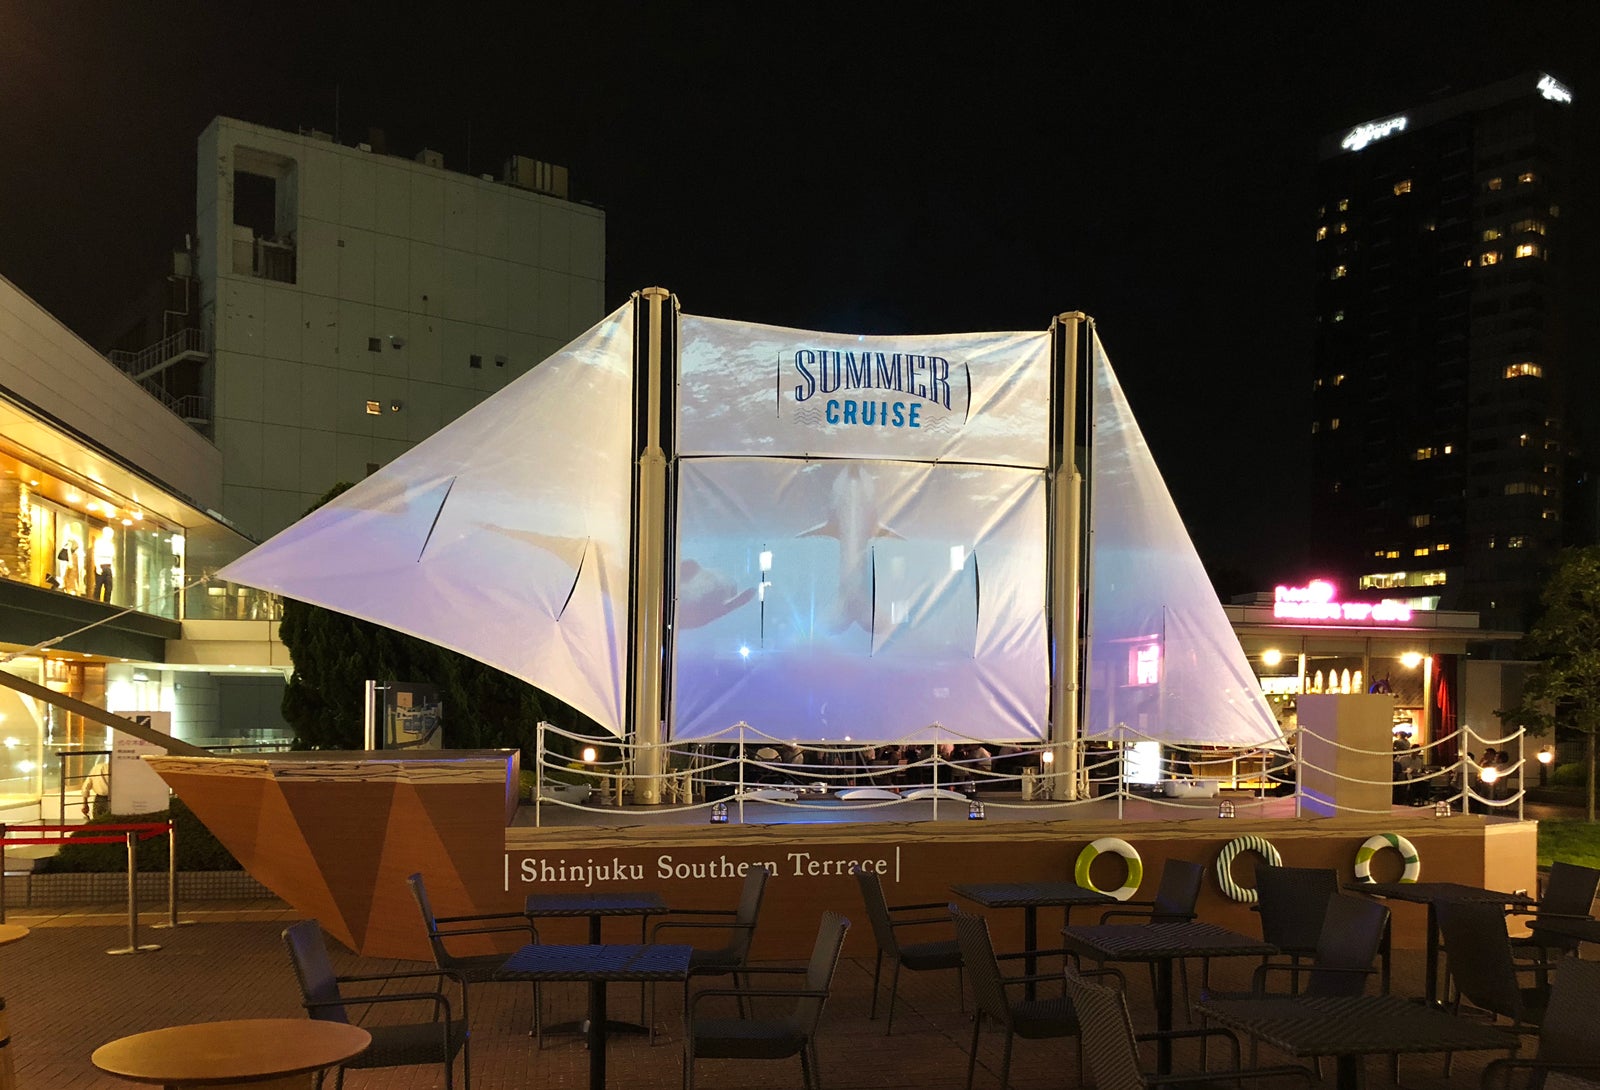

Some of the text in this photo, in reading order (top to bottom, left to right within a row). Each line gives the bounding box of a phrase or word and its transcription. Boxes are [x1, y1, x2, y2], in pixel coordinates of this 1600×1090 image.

[795, 349, 951, 411] SUMMER
[825, 399, 922, 428] CRUISE
[520, 856, 644, 887] Shinjuku
[787, 852, 888, 877] Terrace
